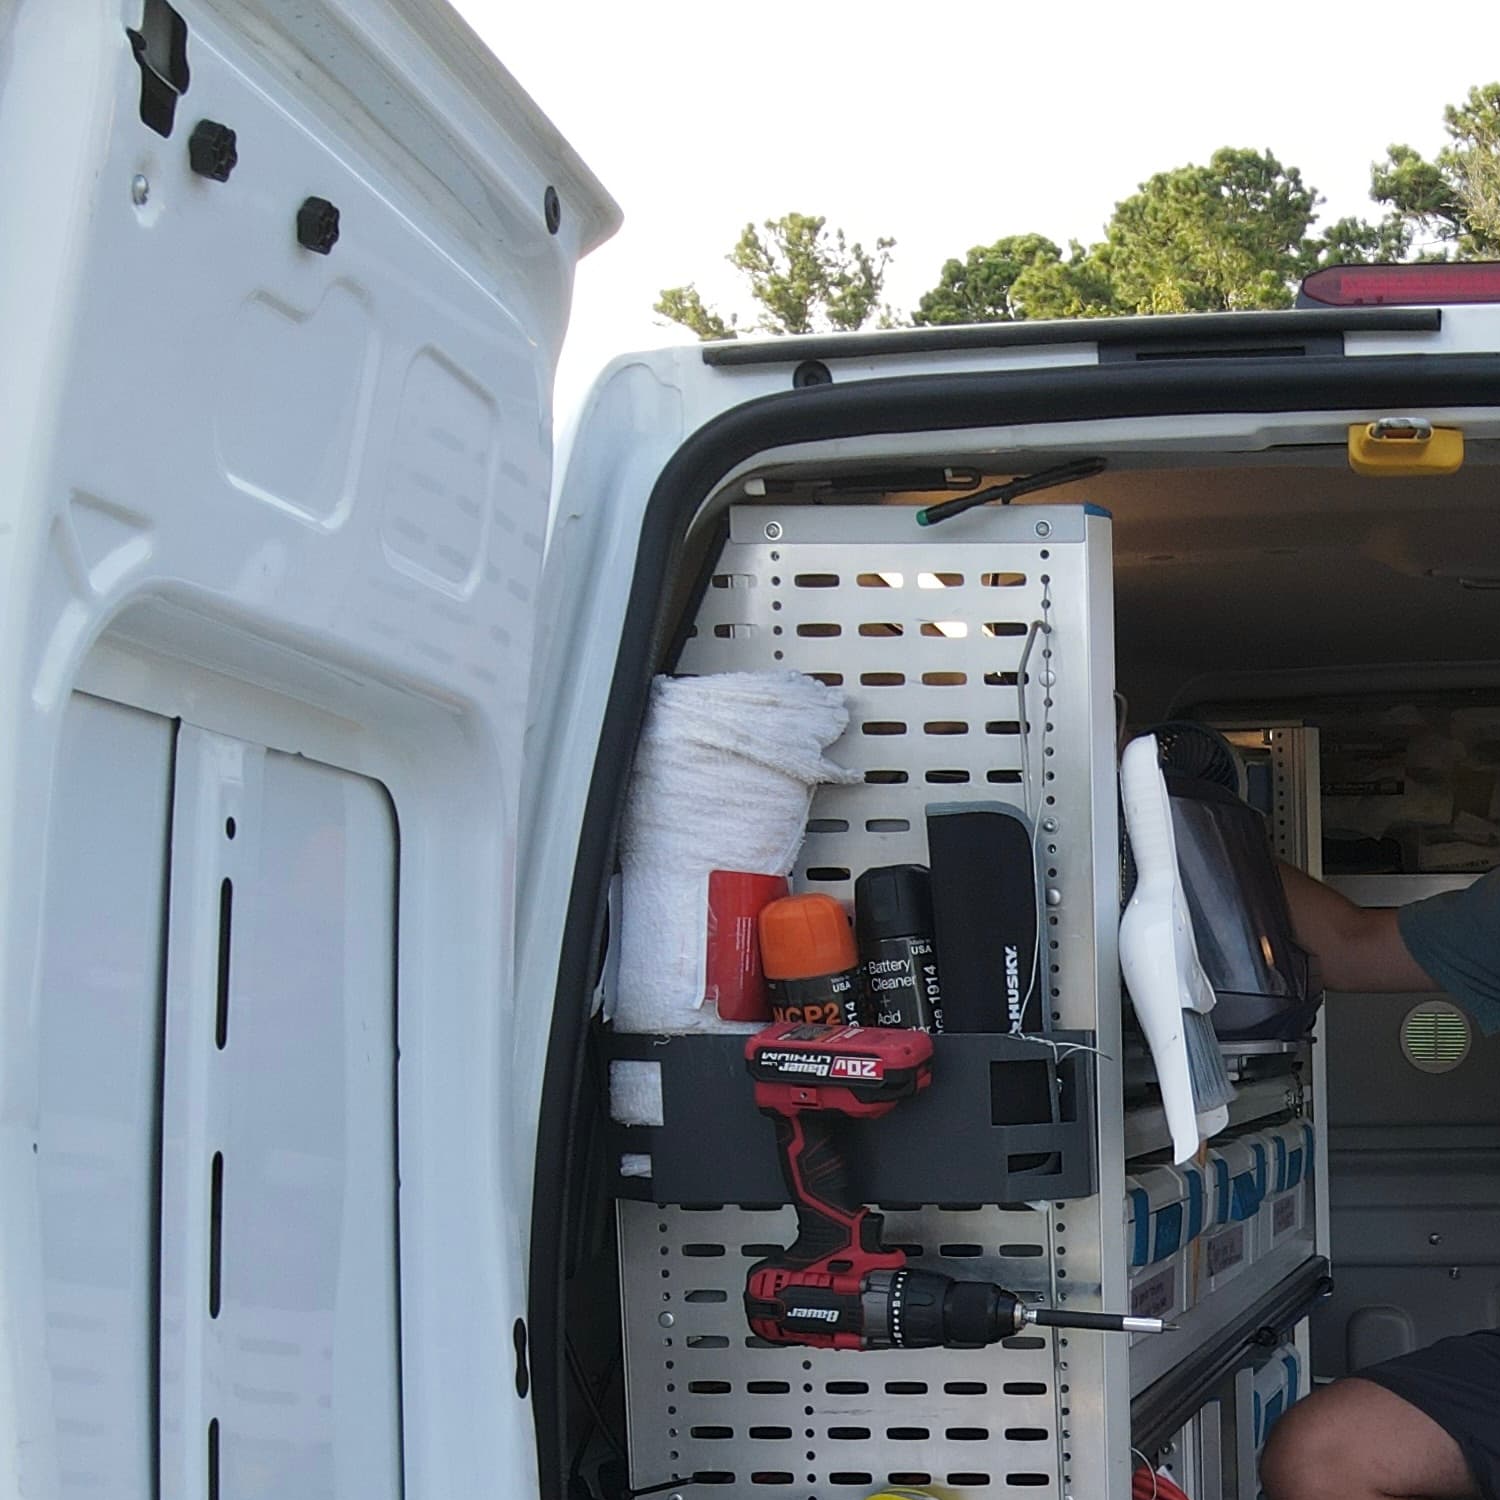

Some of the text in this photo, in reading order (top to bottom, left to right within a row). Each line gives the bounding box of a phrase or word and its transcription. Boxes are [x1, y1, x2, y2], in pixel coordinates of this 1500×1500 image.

[911, 945, 933, 955] USA
[868, 959, 911, 975] Battery
[832, 981, 851, 992] USA
[871, 975, 917, 991] Cleaner
[923, 964, 941, 1003] 1914
[1005, 947, 1020, 1022] HUSKY
[878, 1010, 901, 1025] Acid
[761, 1052, 831, 1064] LITHIUM
[778, 1062, 830, 1077] Bauer
[787, 1308, 839, 1322] Bauer
